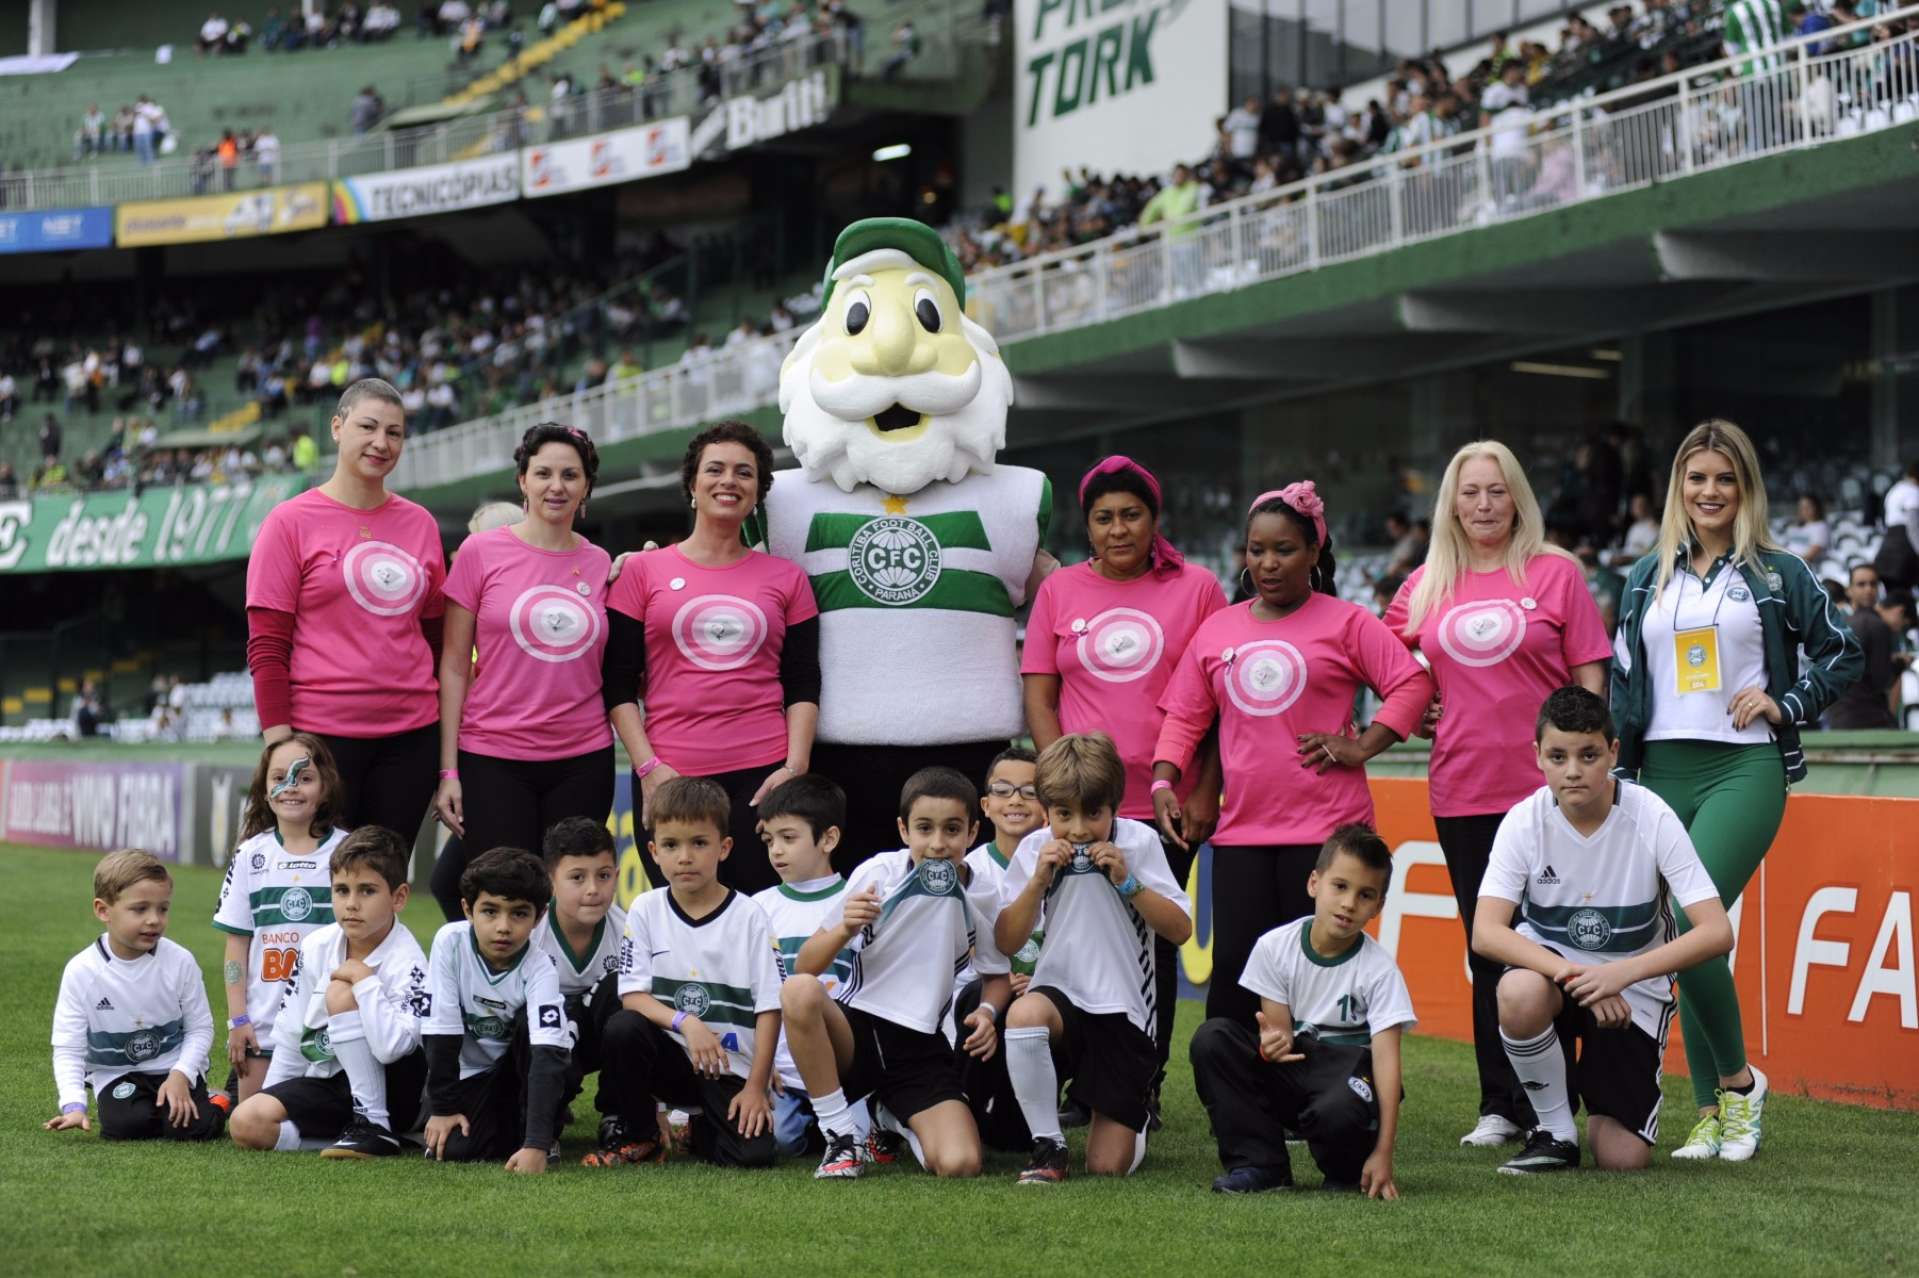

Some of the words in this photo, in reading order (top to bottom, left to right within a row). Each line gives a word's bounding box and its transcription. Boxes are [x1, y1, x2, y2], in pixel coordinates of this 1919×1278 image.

[1027, 8, 1160, 127] TORK
[371, 166, 517, 214] TECNICÓPIAS
[46, 499, 148, 568] desde
[152, 482, 251, 562] 1977
[852, 530, 873, 584] CORITIBA
[872, 519, 906, 531] FOOT
[906, 522, 934, 548] BALL
[925, 550, 938, 580] CLUB
[867, 547, 921, 570] CFC
[875, 587, 921, 601] PARANÁ
[262, 931, 300, 945] BANCO
[1787, 886, 1919, 1030] FA
